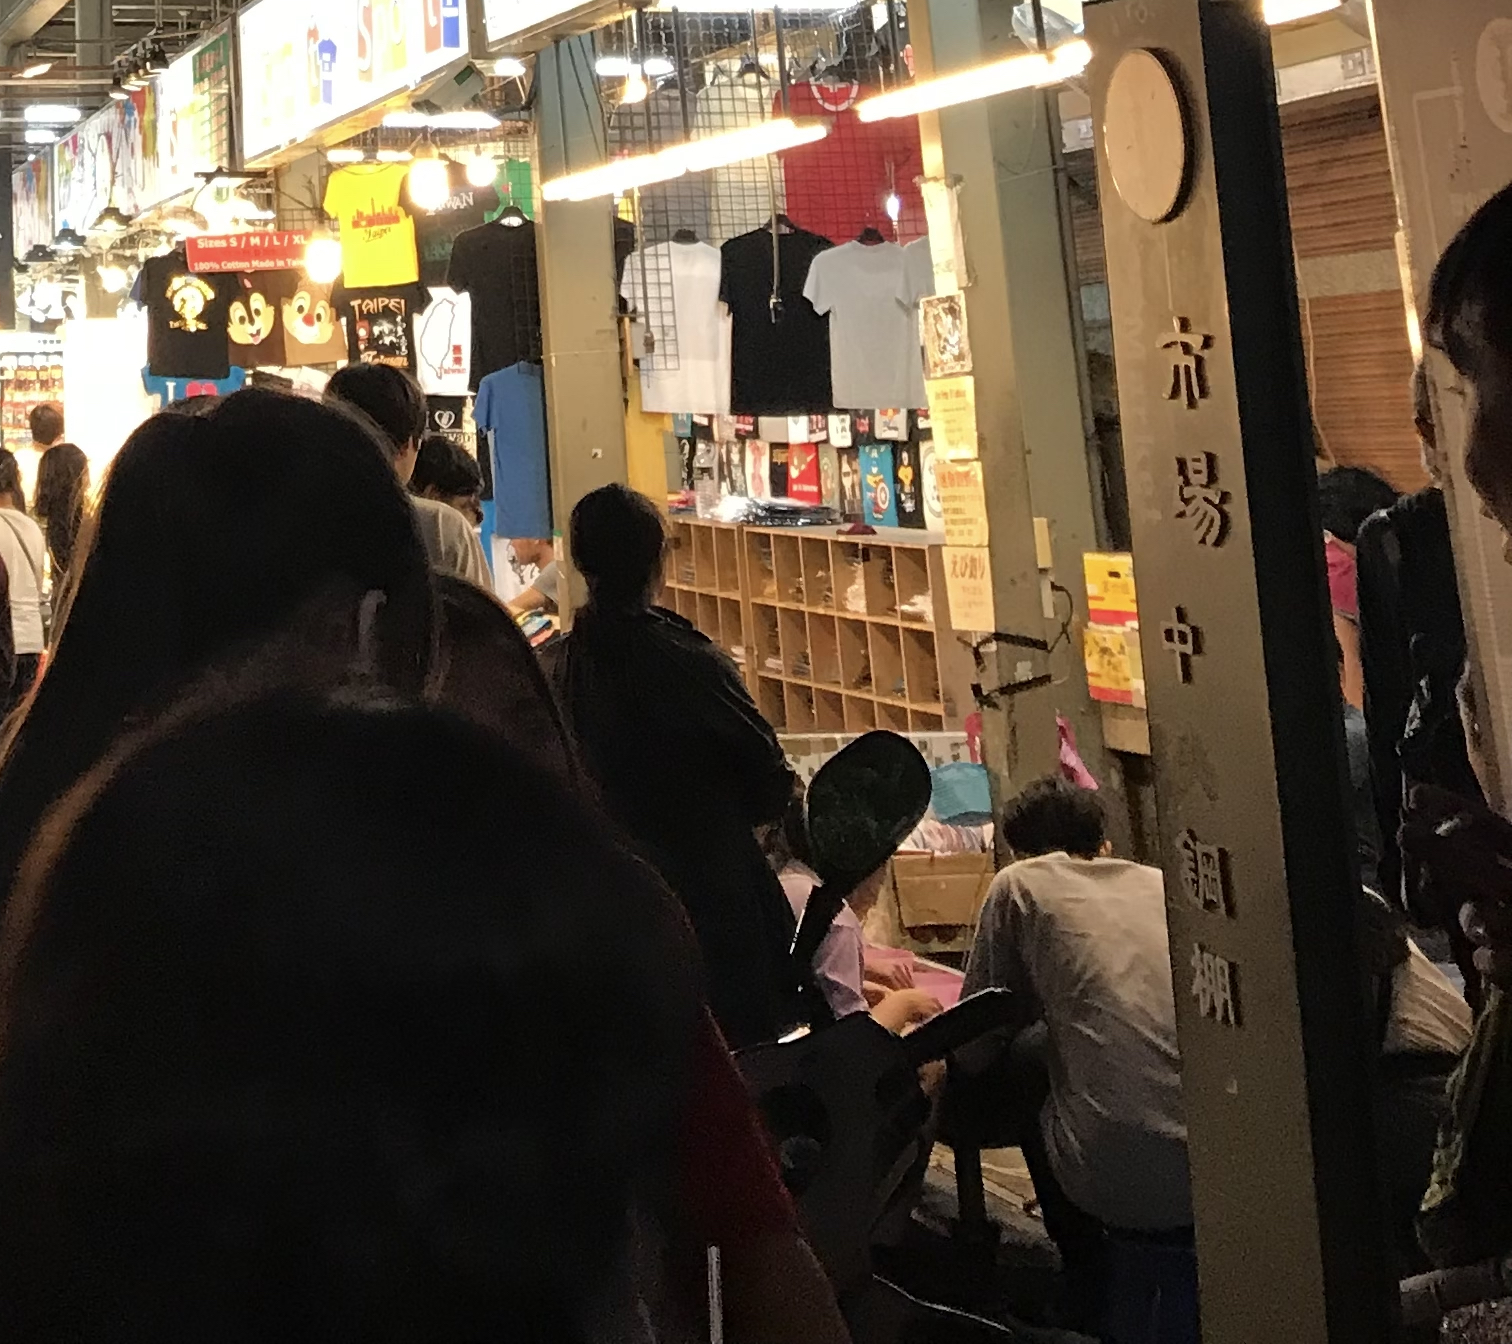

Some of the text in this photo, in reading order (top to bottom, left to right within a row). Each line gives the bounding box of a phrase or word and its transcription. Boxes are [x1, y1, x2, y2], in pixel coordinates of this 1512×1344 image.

[197, 238, 228, 249] Sizes
[249, 236, 261, 247] M
[221, 260, 250, 270] Cotton
[350, 297, 406, 322] TAIPEI
